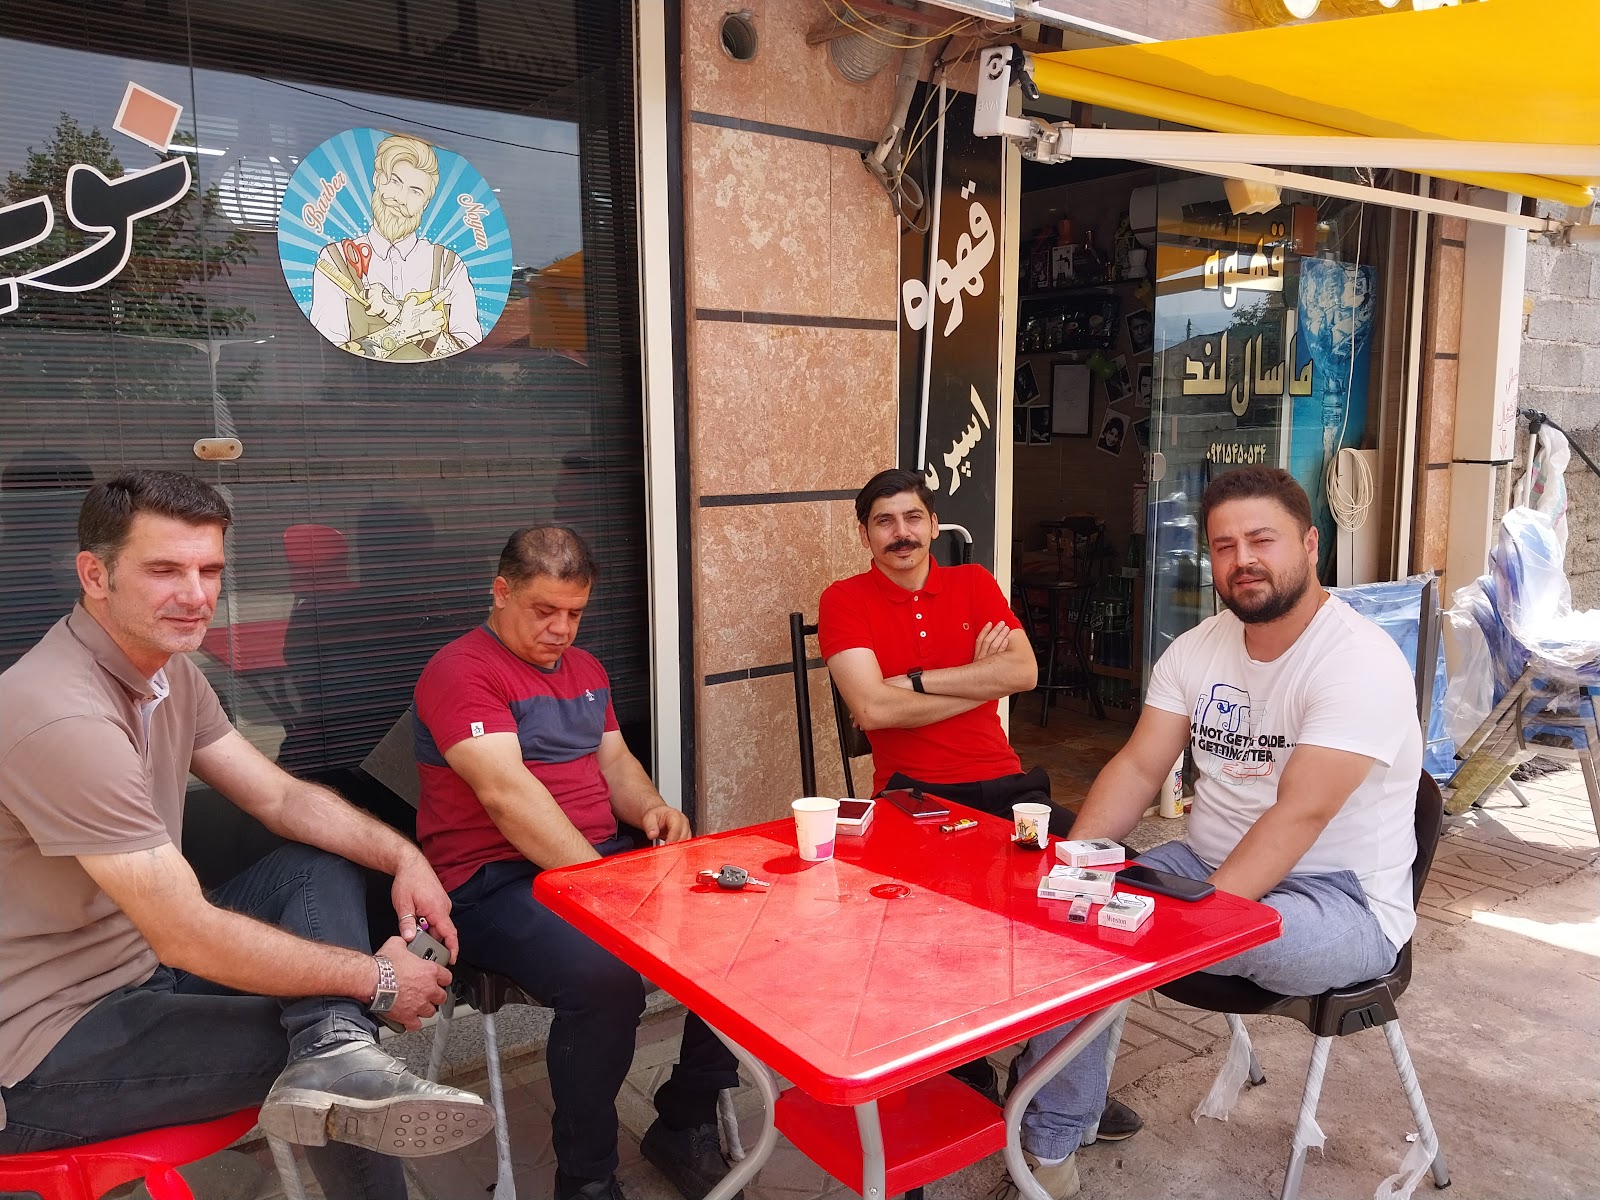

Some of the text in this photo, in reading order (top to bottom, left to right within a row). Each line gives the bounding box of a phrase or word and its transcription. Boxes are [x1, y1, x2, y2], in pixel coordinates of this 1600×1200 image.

[302, 171, 346, 234] Barber
[457, 193, 489, 251] Noyan
[902, 179, 996, 338] قهوه
[1203, 222, 1285, 308] قهوه
[1182, 330, 1228, 395] لند
[924, 384, 991, 496] اسپر
[1200, 724, 1223, 741] NOT
